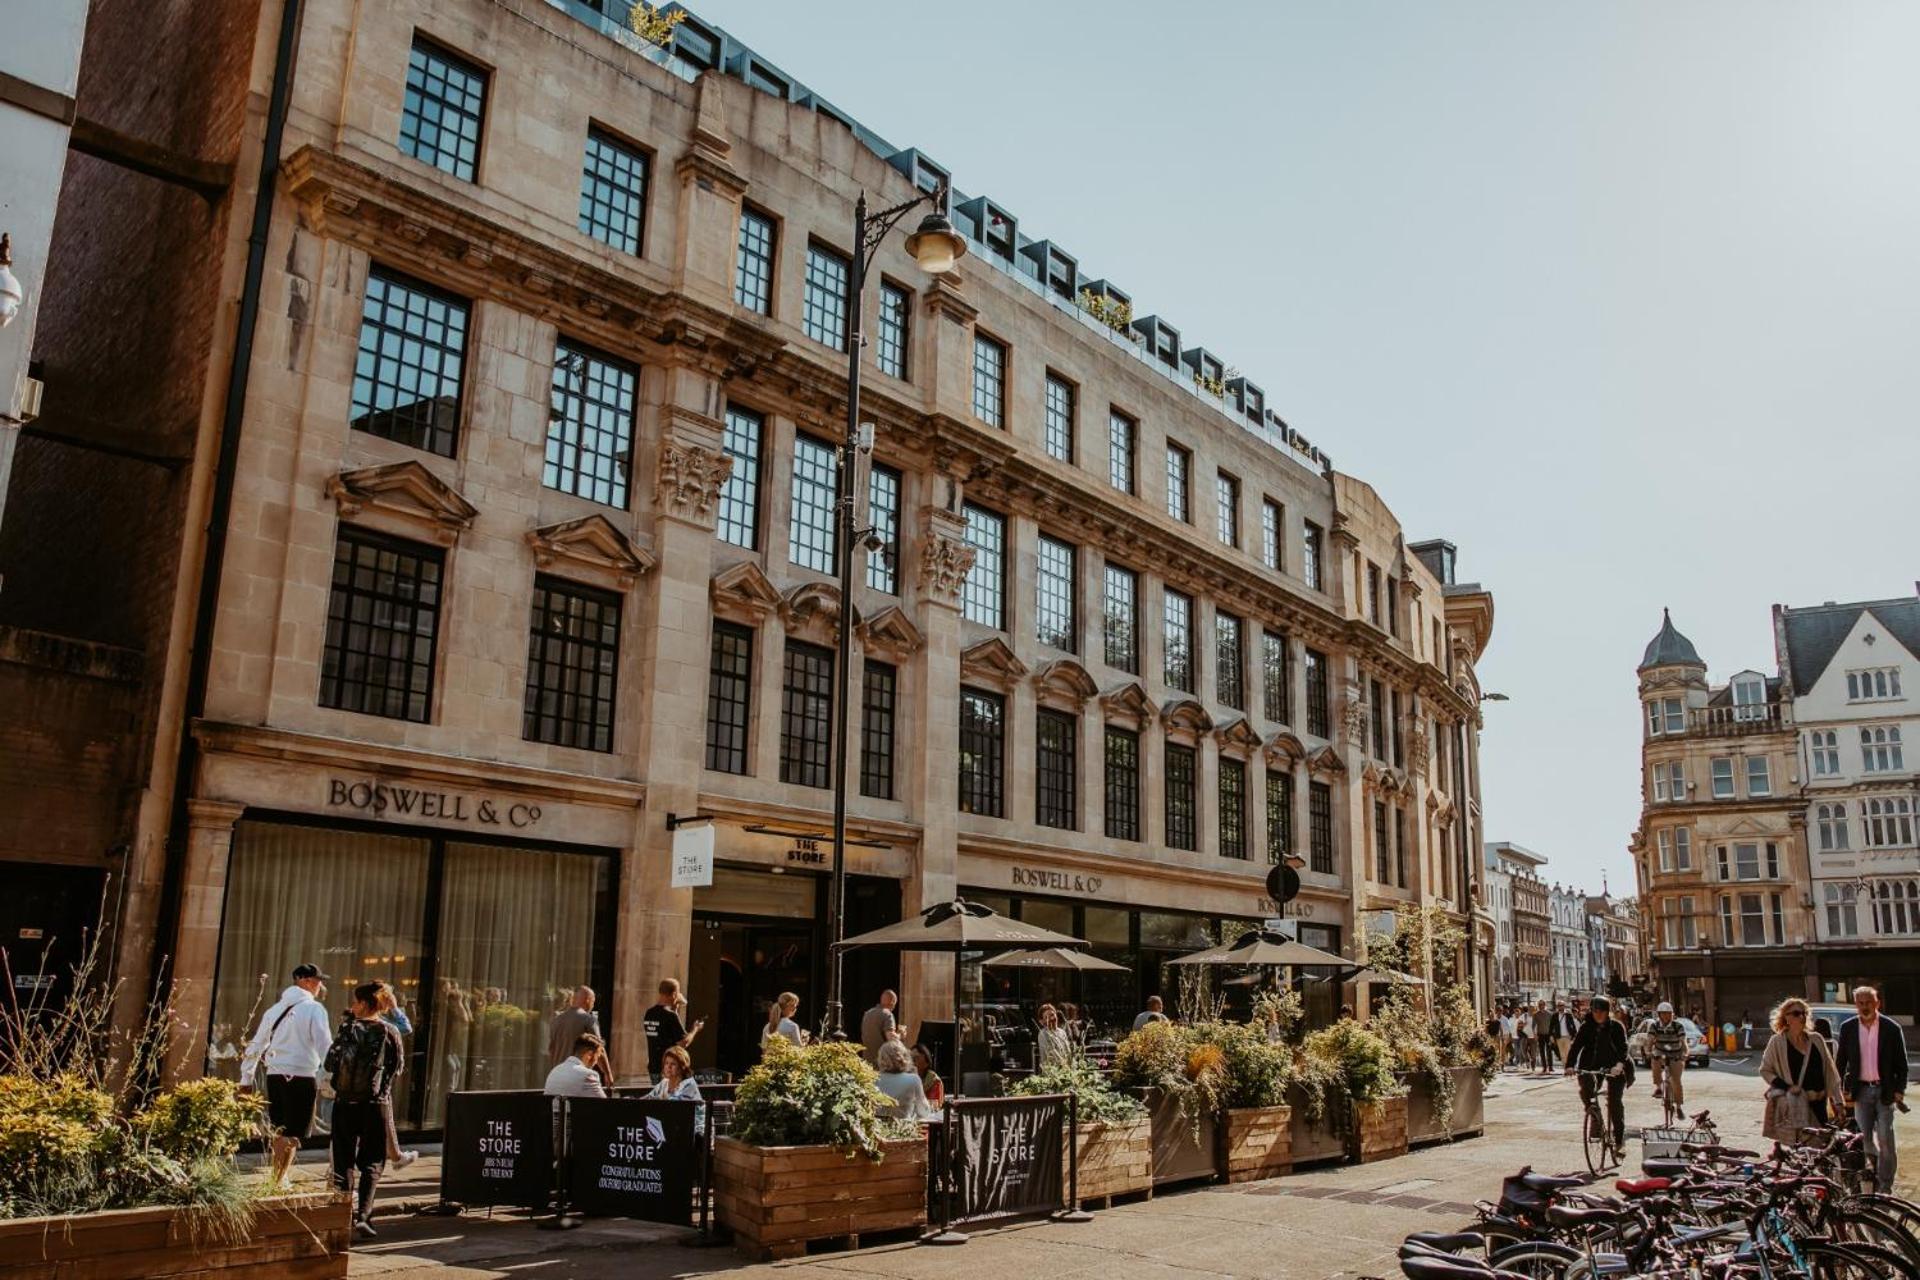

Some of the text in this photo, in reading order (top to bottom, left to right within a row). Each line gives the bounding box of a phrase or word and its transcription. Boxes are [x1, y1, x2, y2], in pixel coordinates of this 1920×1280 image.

[329, 779, 469, 821] BOSWELL
[477, 799, 500, 825] &
[795, 839, 819, 851] THE
[787, 850, 827, 864] STORE
[1012, 866, 1073, 891] BOSWELL
[1074, 875, 1085, 892] &
[487, 1120, 512, 1136] THE
[617, 1126, 644, 1143] THE
[1000, 1127, 1026, 1143] THE
[479, 1137, 521, 1155] STORE
[608, 1142, 655, 1161] STORE
[992, 1144, 1035, 1164] STORE
[601, 1164, 662, 1181] CONGRATULATIONS
[622, 1180, 663, 1193] GRADUATES
